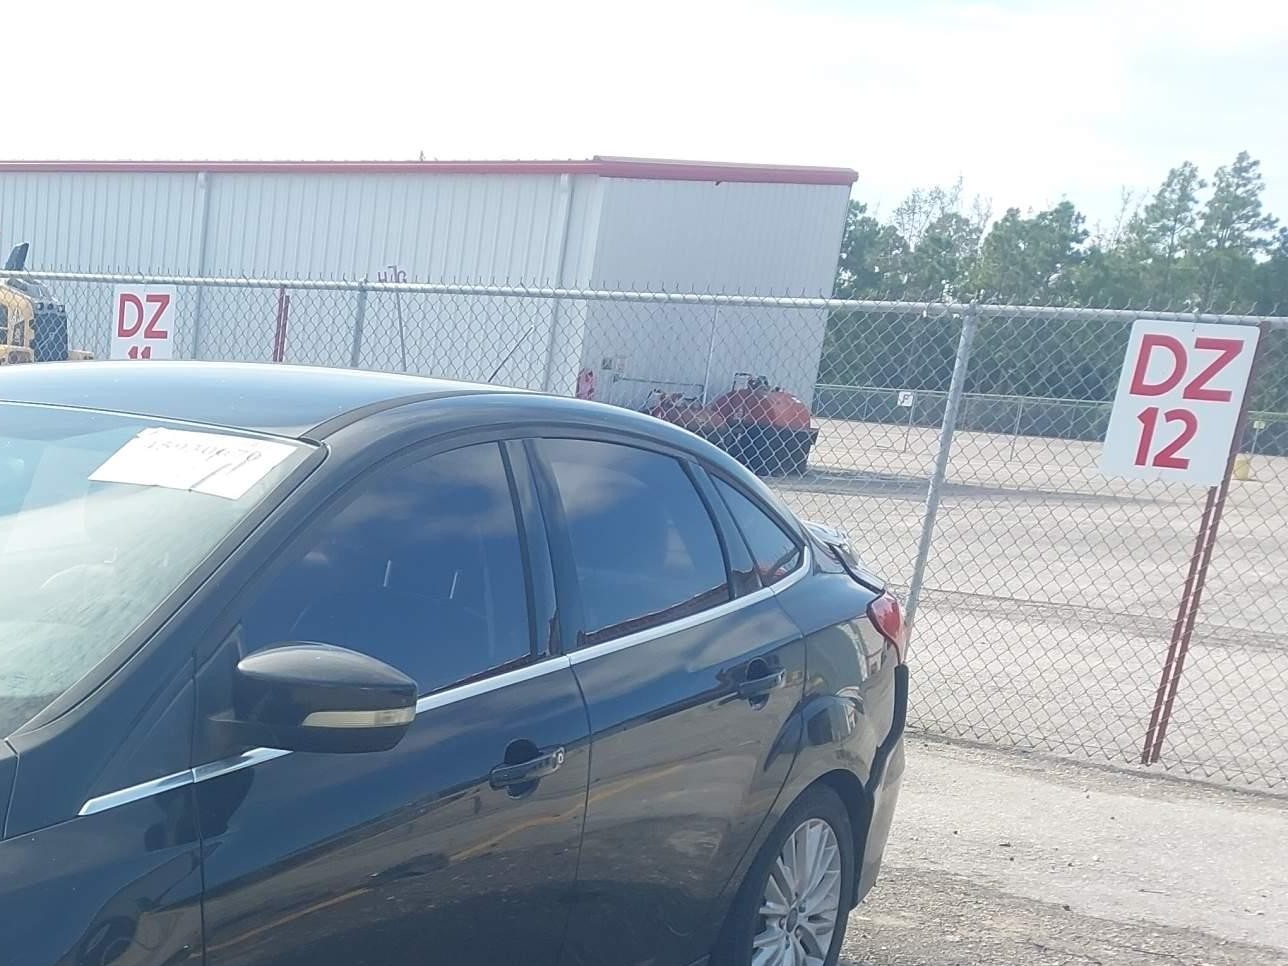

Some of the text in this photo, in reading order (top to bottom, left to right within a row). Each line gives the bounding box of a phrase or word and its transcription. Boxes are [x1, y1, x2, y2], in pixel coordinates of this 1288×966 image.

[118, 293, 171, 340] DZ
[1129, 333, 1245, 403] DZ
[1134, 406, 1198, 470] 12
